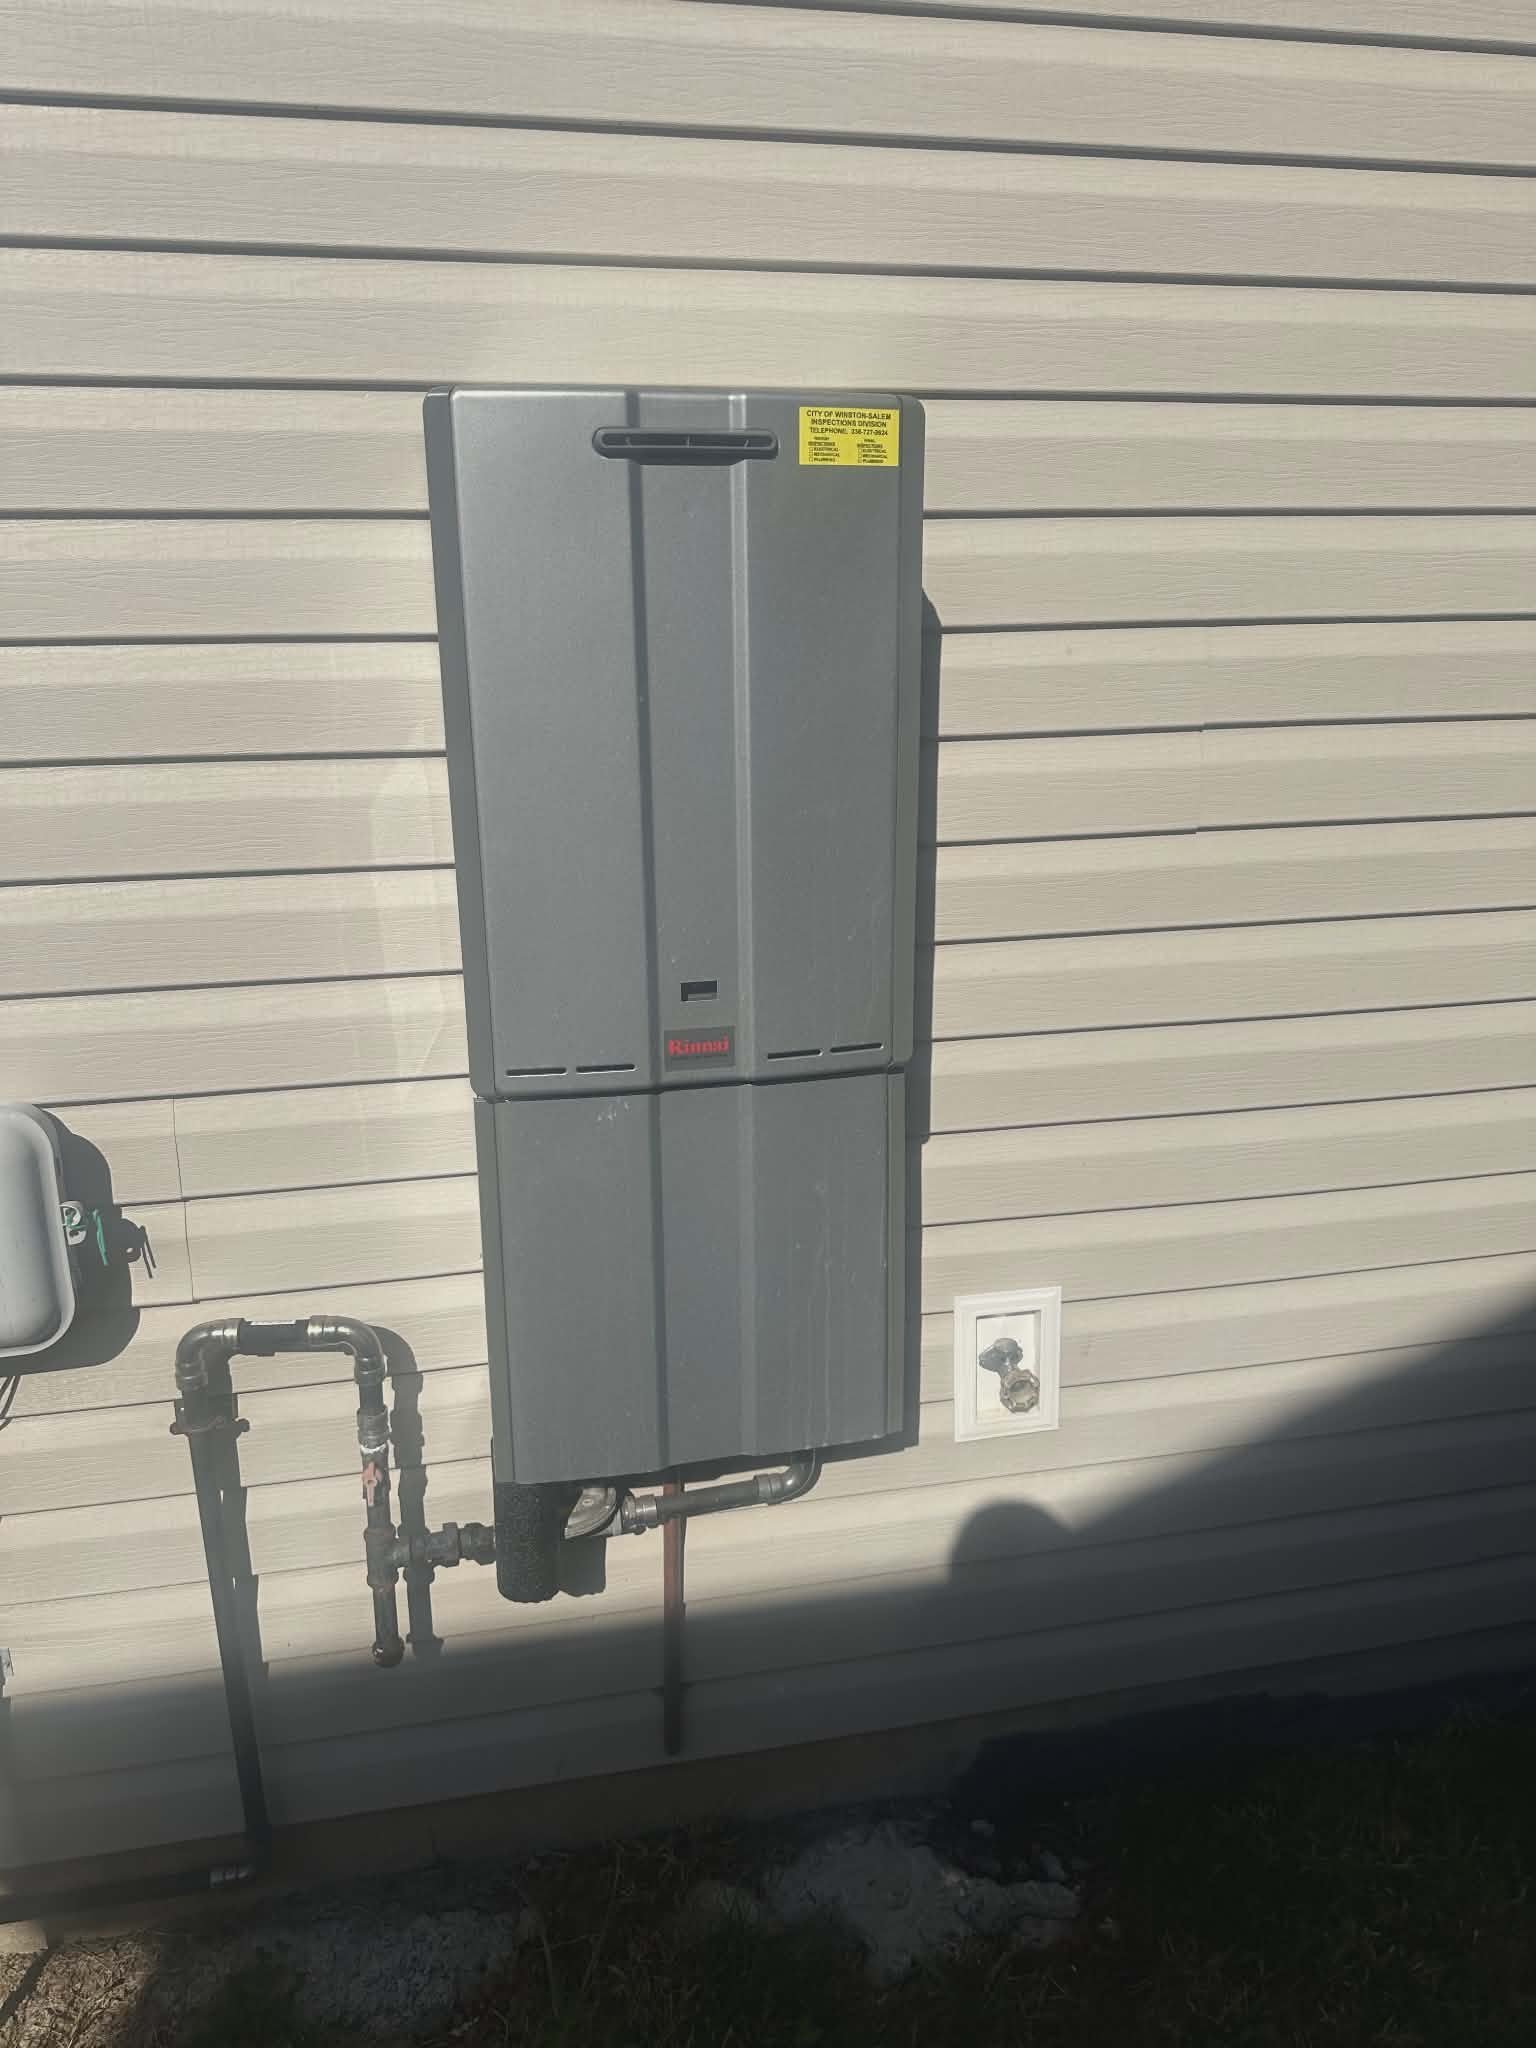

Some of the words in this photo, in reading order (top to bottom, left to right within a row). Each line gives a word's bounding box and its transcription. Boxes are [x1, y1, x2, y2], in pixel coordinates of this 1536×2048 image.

[834, 411, 892, 420] WINSTON-SALEM
[811, 418, 857, 426] INSPECTIONS
[858, 420, 887, 428] DIVISION
[669, 1036, 729, 1055] Rinnai
